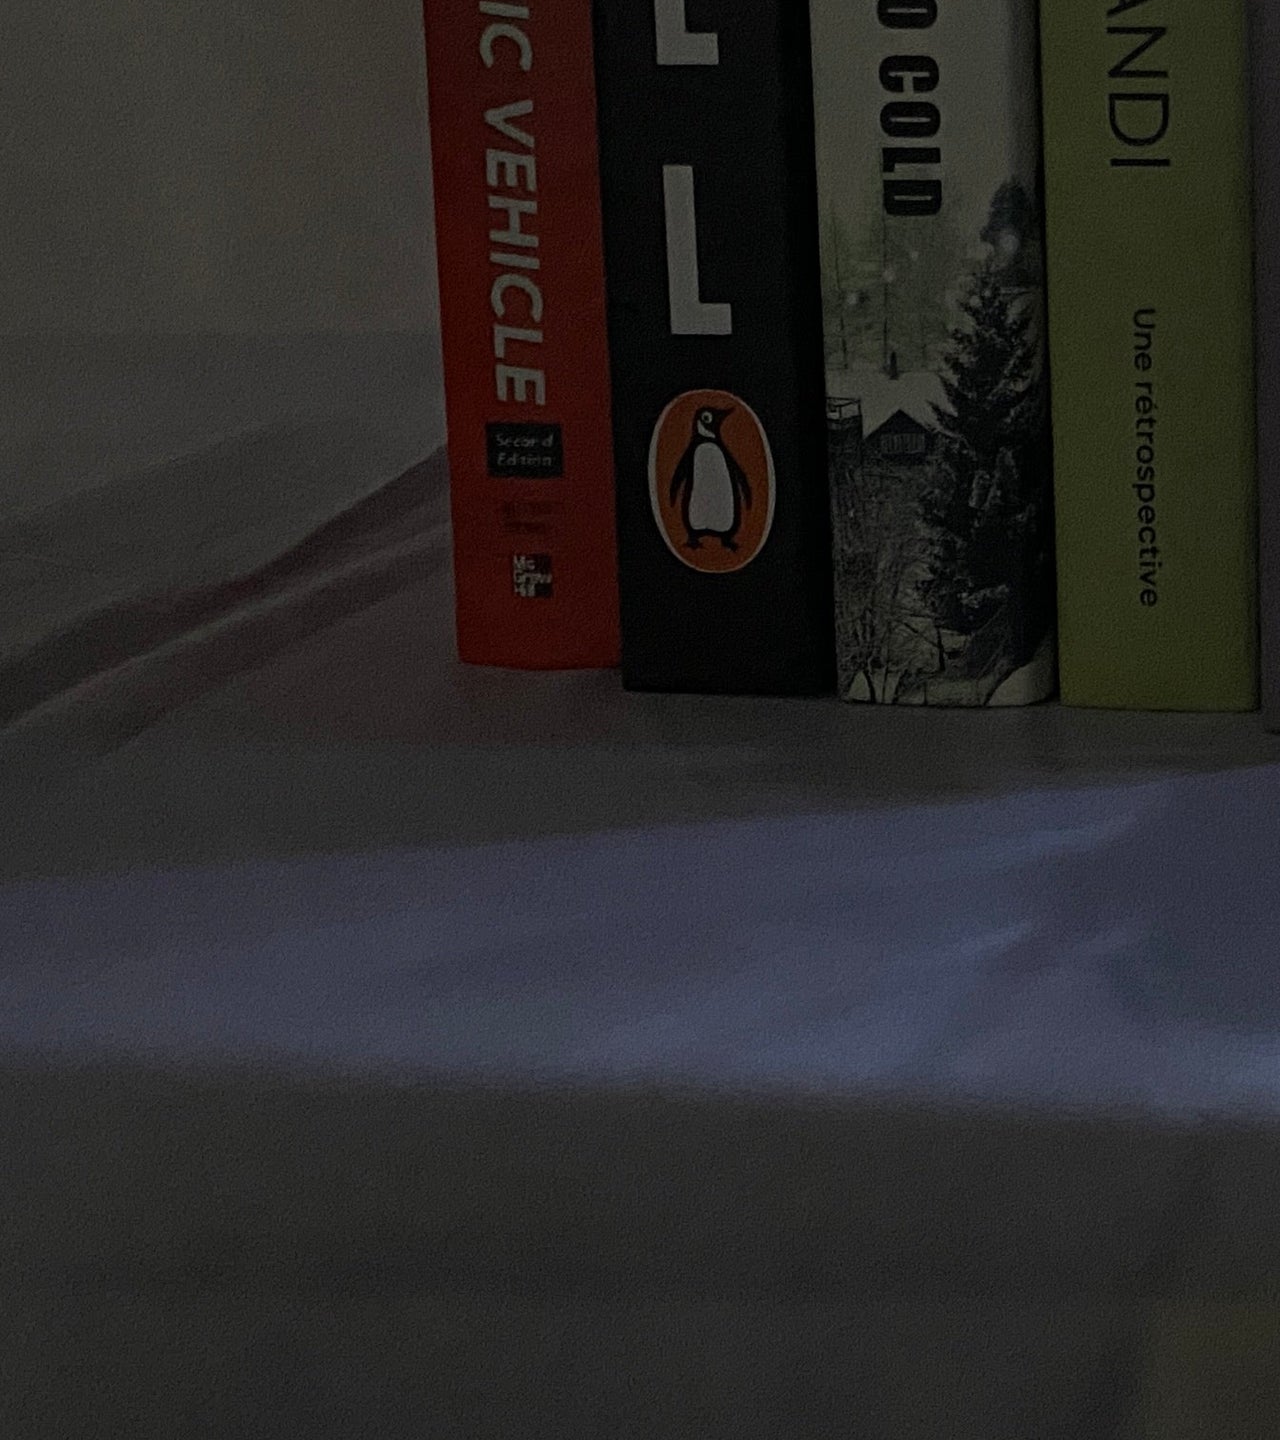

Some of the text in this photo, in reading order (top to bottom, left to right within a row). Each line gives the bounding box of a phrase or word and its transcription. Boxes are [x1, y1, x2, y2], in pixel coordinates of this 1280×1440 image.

[483, 99, 547, 406] VEHICLE
[878, 55, 942, 216] COLD
[1131, 308, 1159, 608] Une rétrospective
